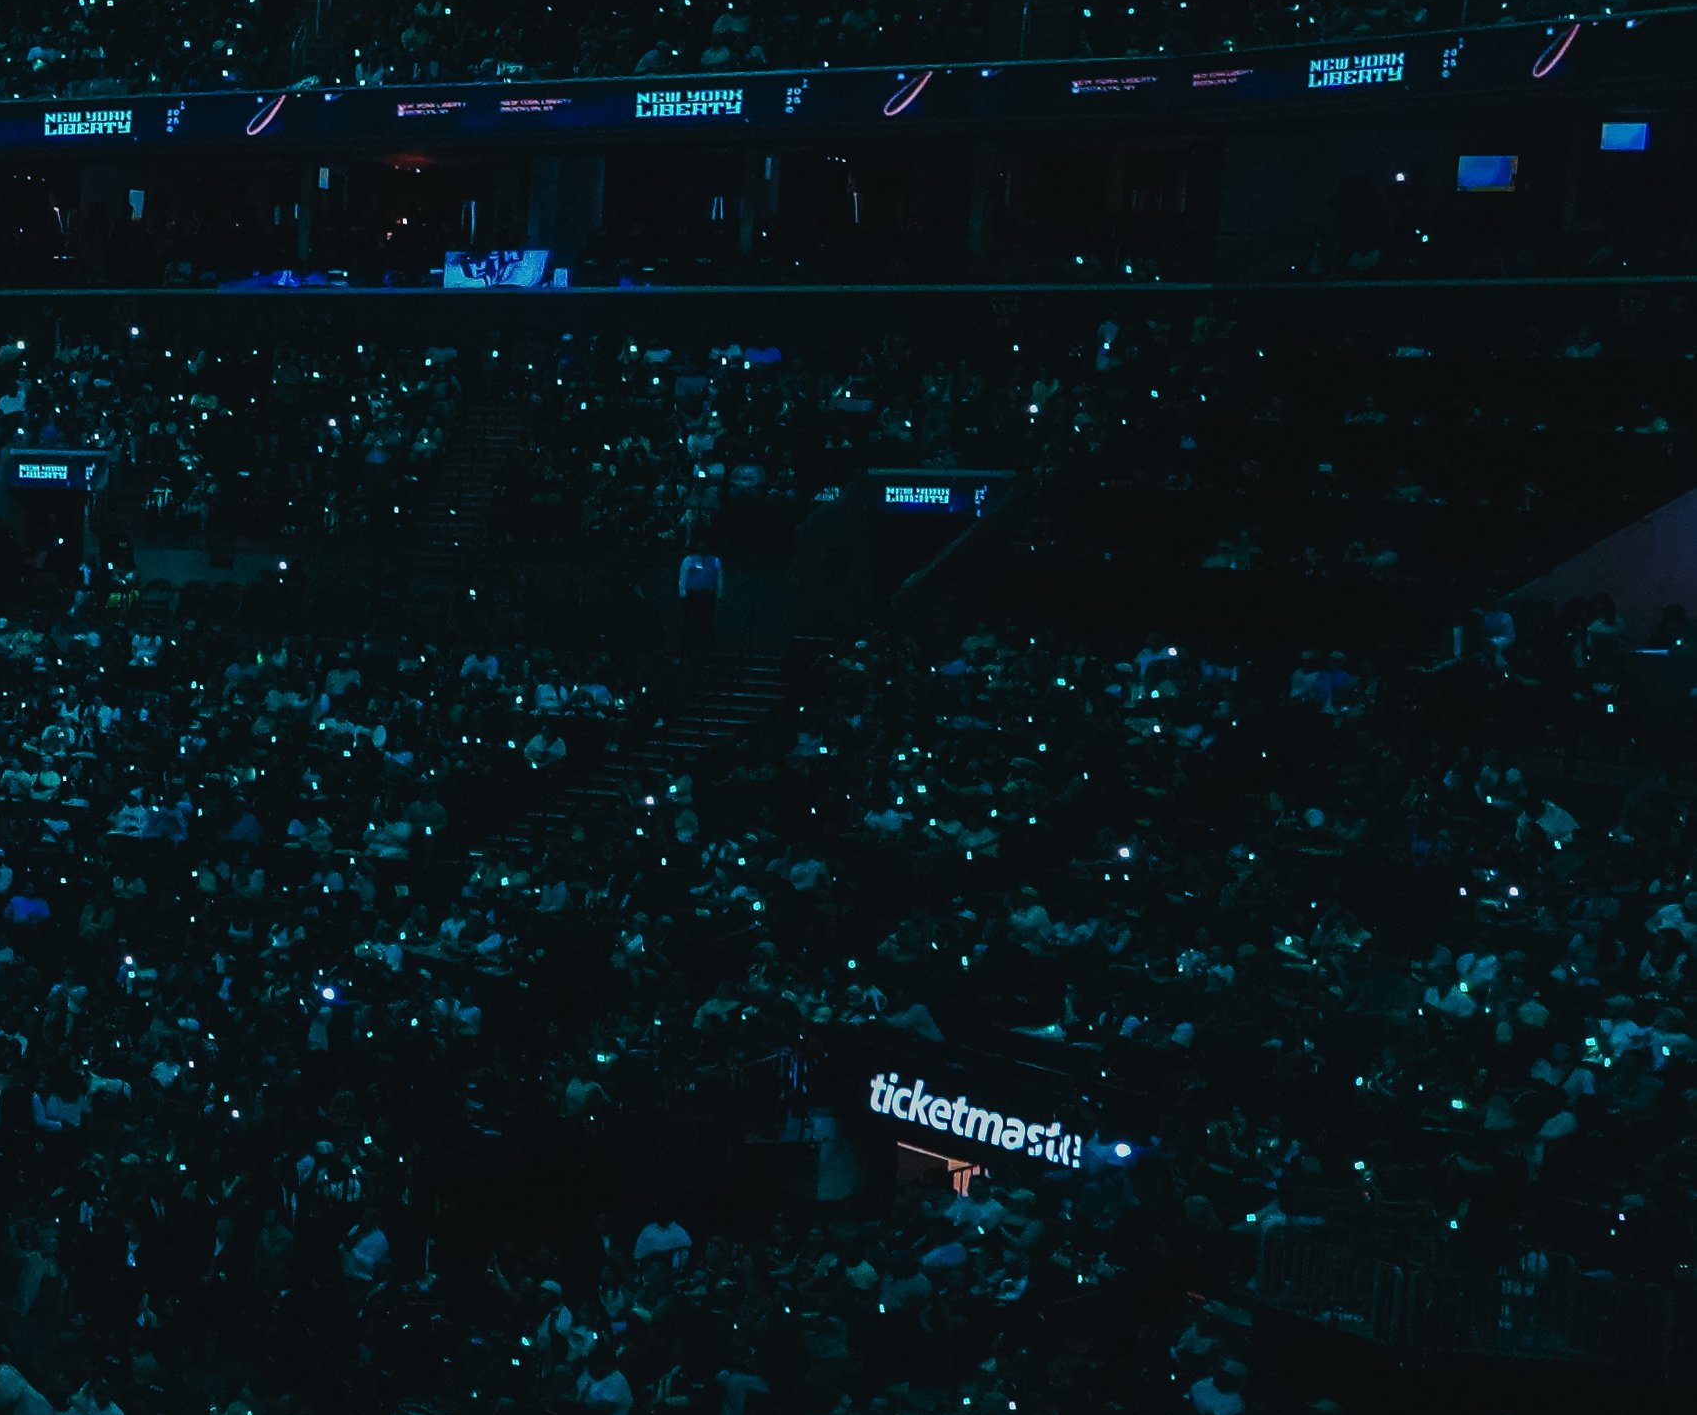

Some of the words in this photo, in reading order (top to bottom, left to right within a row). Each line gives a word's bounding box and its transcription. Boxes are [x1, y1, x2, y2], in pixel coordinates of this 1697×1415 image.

[1309, 57, 1350, 73] NEW
[1354, 51, 1405, 68] YORK
[1308, 67, 1405, 88] LIBERTY
[635, 90, 683, 103] NEW
[687, 88, 744, 101] YORK
[44, 112, 83, 123] NEW
[86, 110, 132, 122] YORK
[635, 100, 743, 118] LIBERTY
[44, 121, 132, 136] LIBERTY
